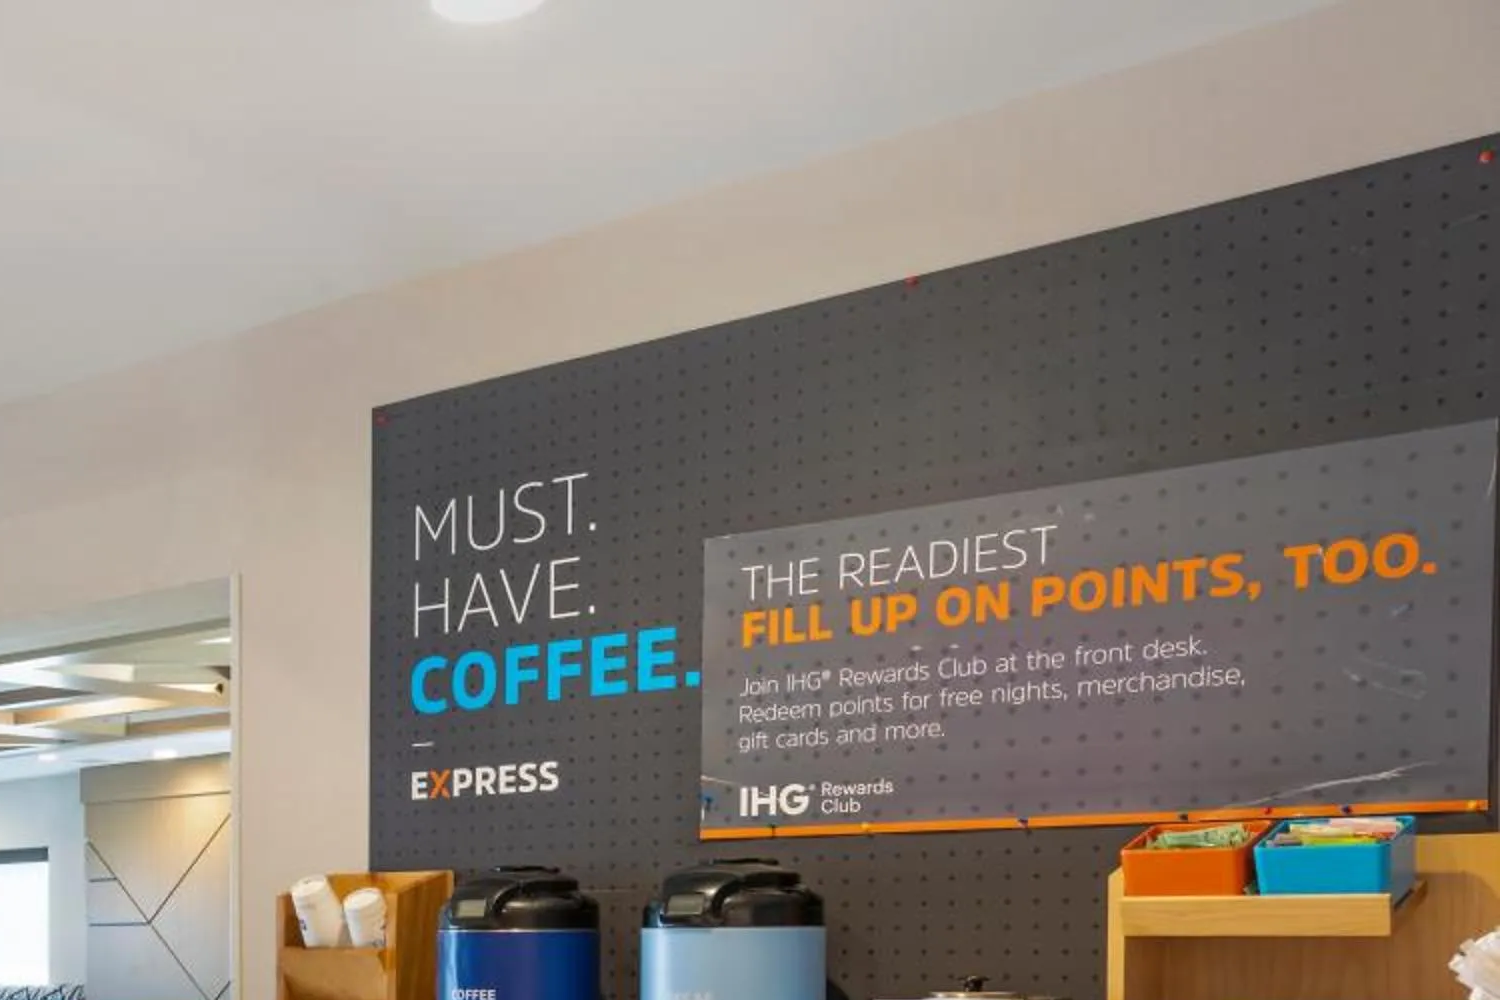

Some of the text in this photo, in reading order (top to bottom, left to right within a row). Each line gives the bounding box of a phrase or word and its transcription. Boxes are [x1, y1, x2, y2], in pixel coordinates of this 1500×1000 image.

[414, 472, 597, 561] MUST.
[741, 524, 1058, 601] THE READIEST
[741, 532, 1438, 648] FILL UP ON POINTS, TOO.
[414, 556, 596, 639] HAVE.
[410, 626, 700, 715] COFFEE.
[739, 677, 780, 698] Join
[838, 661, 931, 687] Rewards
[937, 655, 988, 679] Club
[995, 654, 1017, 673] at
[1026, 650, 1065, 670] the
[1074, 642, 1132, 667] front
[1142, 634, 1209, 661] desk.
[739, 665, 1246, 724] Redeem points for free nights, merchandise,
[738, 720, 946, 754] gift cards and more.
[411, 760, 560, 801] EXPRESS
[820, 798, 861, 814] Club
[821, 777, 894, 797] Rewards
